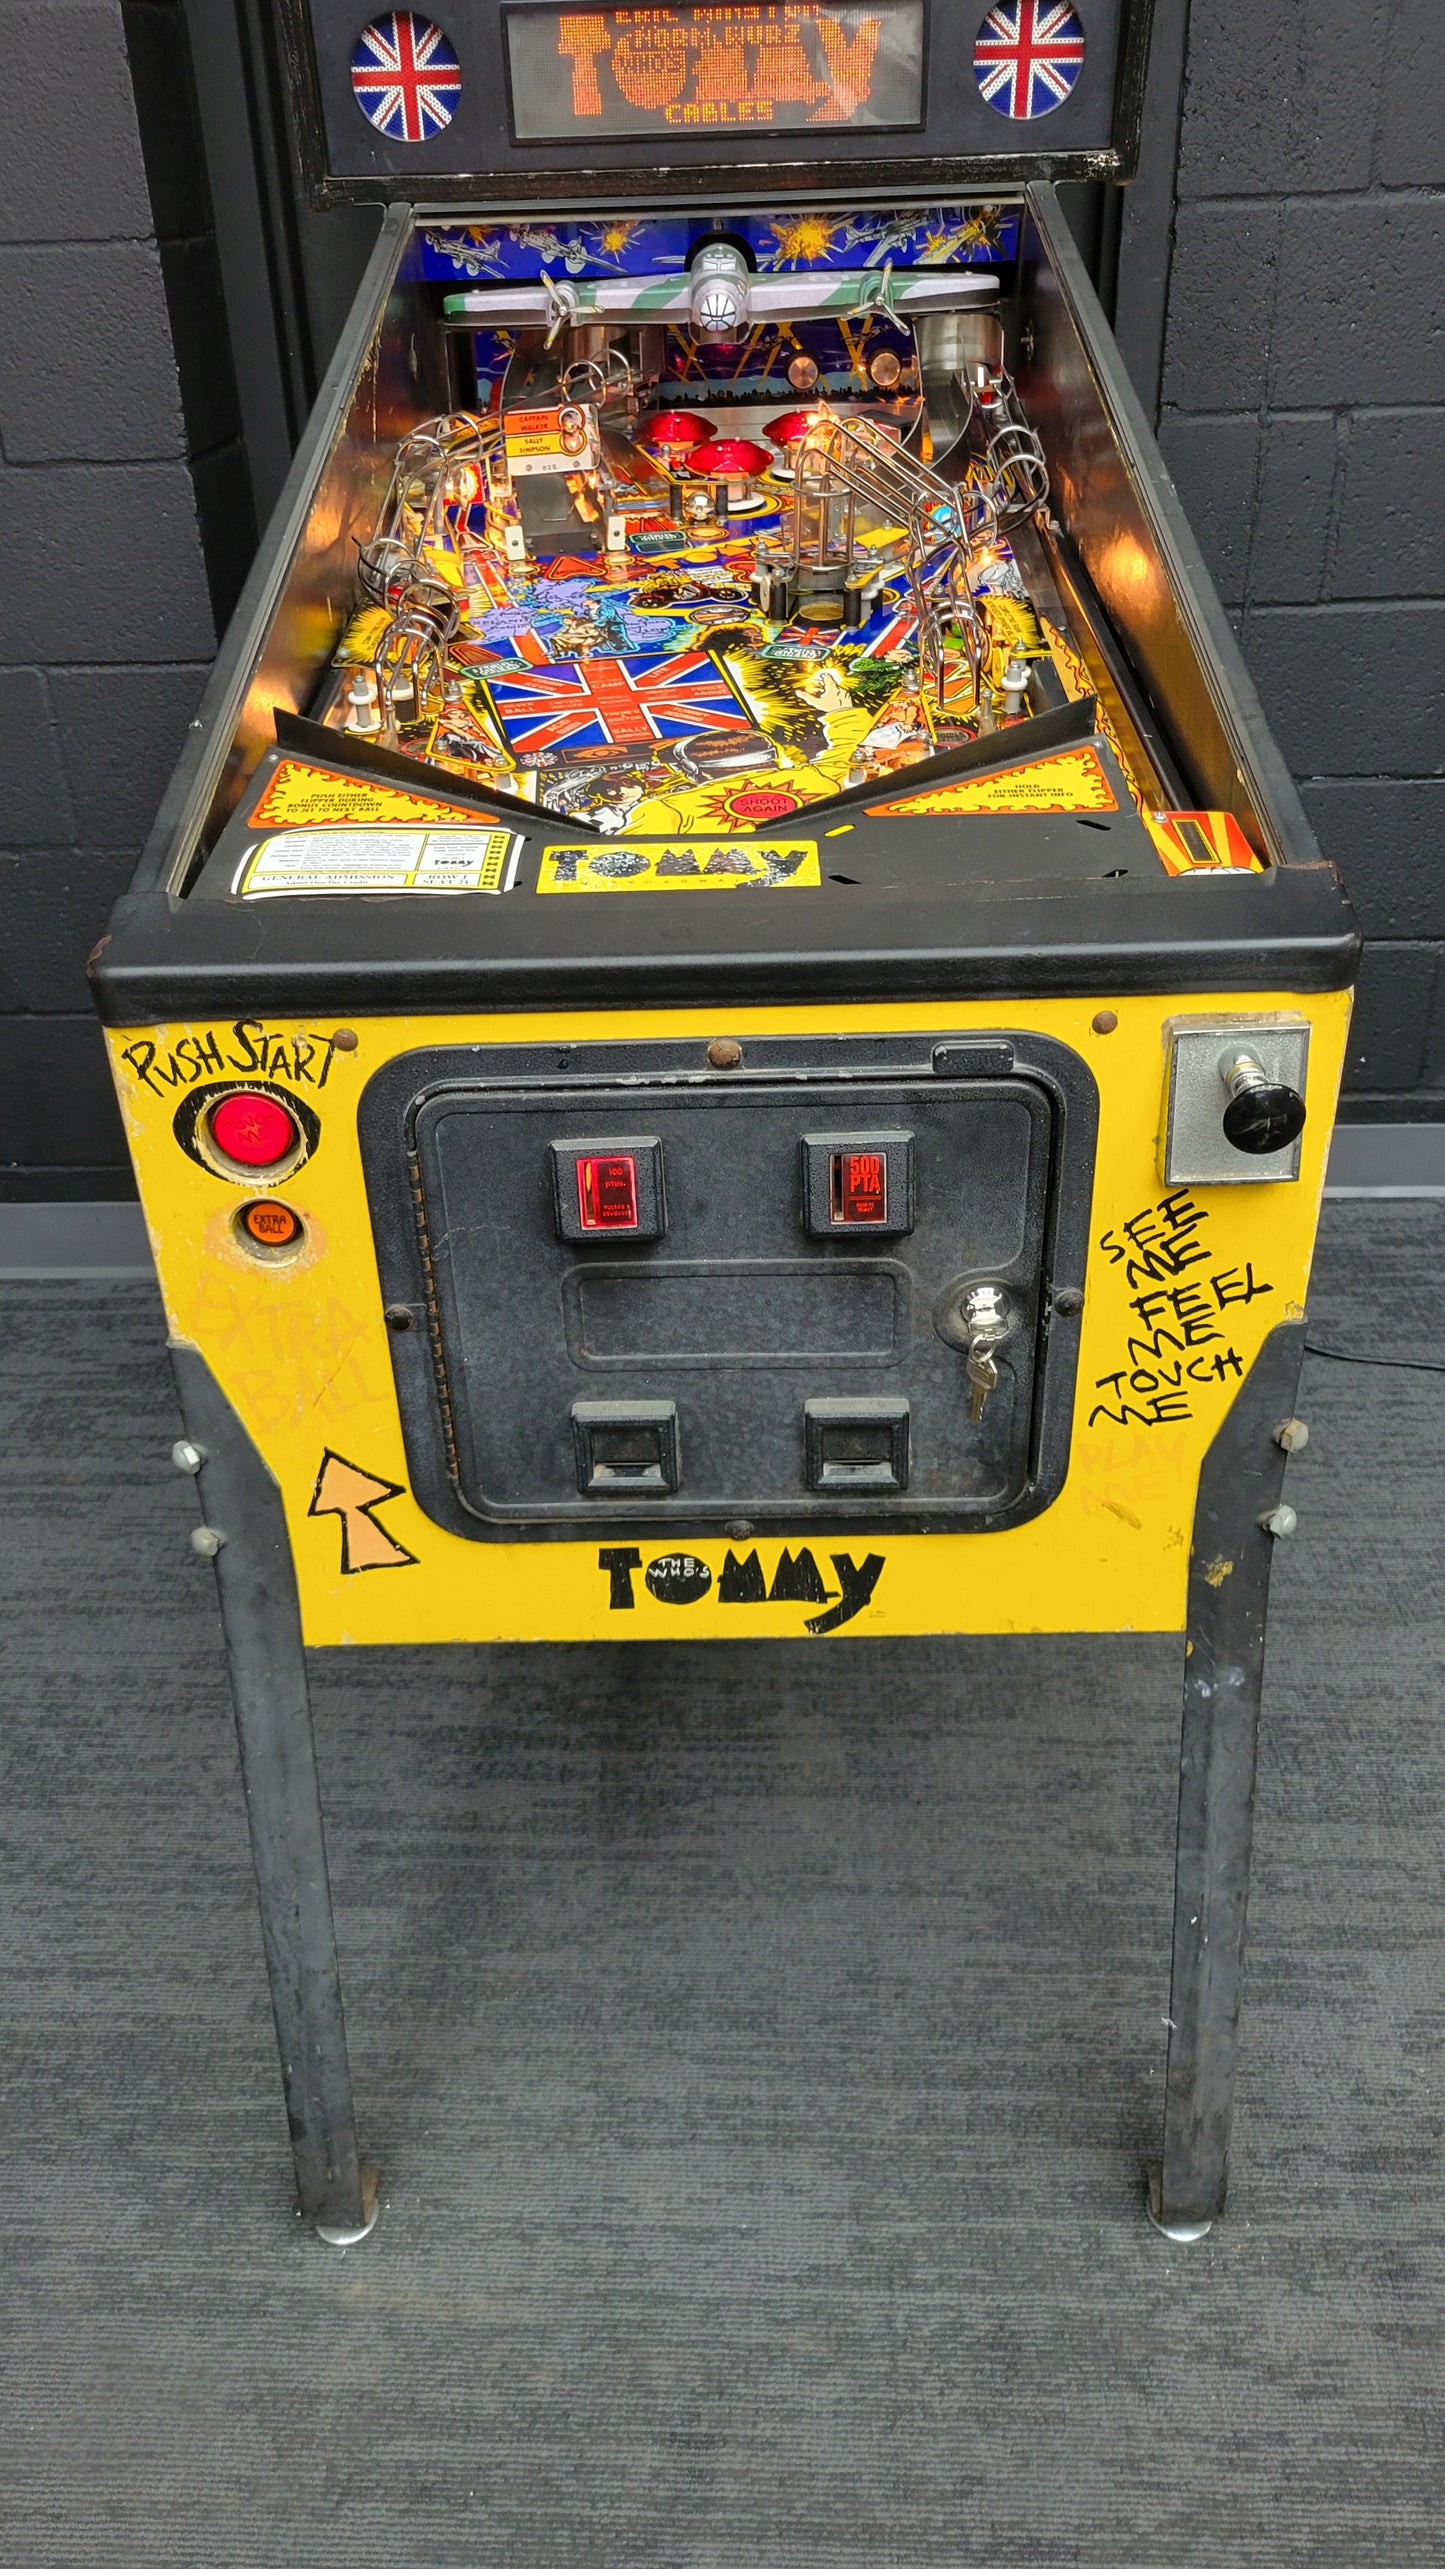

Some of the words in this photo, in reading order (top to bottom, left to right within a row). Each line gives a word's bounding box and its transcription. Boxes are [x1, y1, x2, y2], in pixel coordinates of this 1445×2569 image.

[724, 23, 800, 46] WURZ
[664, 100, 774, 124] CABLES
[519, 414, 549, 423] CAPTAIN
[520, 423, 549, 432] WALKER
[524, 437, 543, 445] SALLY
[519, 446, 551, 454] SIMPSON
[591, 680, 625, 689] CAMP
[612, 725, 648, 734] SALLY
[743, 805, 788, 813] AGAIN
[549, 847, 808, 888] TOMMY
[261, 873, 323, 881] GENERAL
[608, 1167, 624, 1176] 100
[849, 1156, 880, 1175] 500
[849, 1173, 881, 1193] PTA
[253, 1214, 287, 1225] EXTRA
[258, 1223, 284, 1235] BALL
[1099, 1188, 1210, 1264] SEE
[1126, 1223, 1212, 1289] ME
[1129, 1262, 1274, 1331] FEEL
[1127, 1312, 1226, 1366] ME
[1095, 1347, 1243, 1400] TOUCH
[1088, 1391, 1193, 1428] ME
[658, 1557, 695, 1569] THE
[649, 1567, 710, 1579] WHO'S
[598, 1545, 886, 1635] TOMMY
